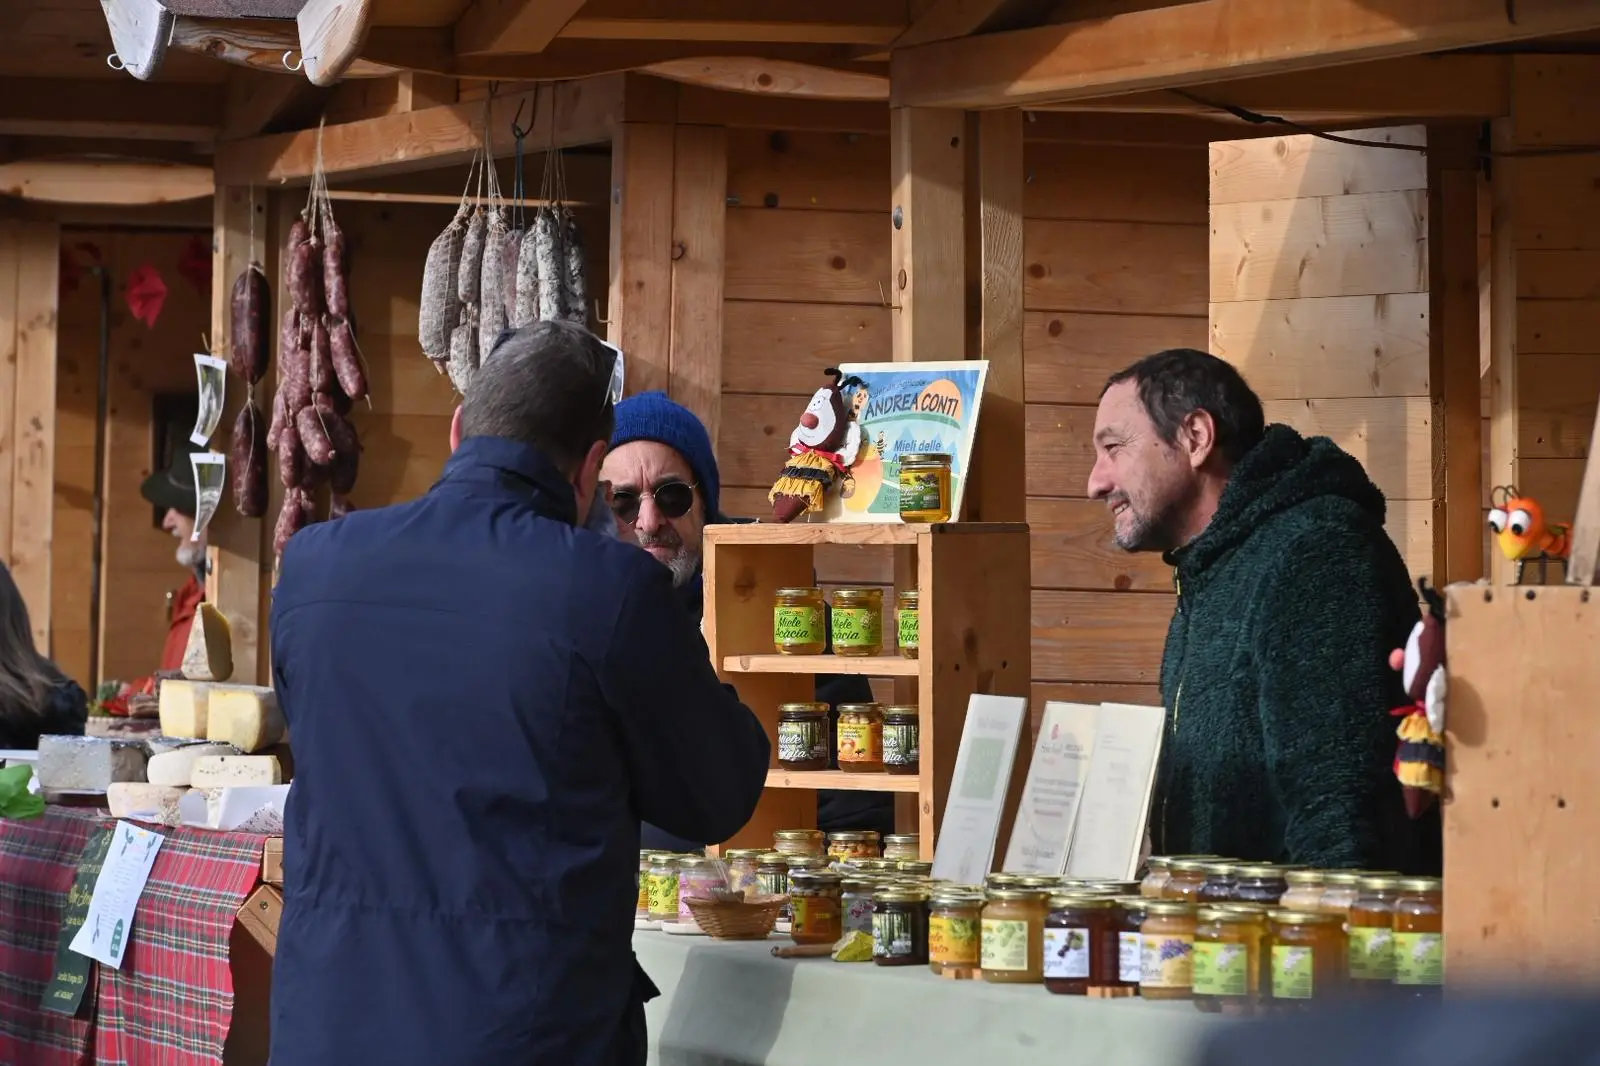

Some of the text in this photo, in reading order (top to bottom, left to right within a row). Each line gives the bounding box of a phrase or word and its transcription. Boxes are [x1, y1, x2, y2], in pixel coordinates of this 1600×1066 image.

[864, 392, 959, 421] ANDREA CONTI
[893, 439, 941, 452] Mieli delle
